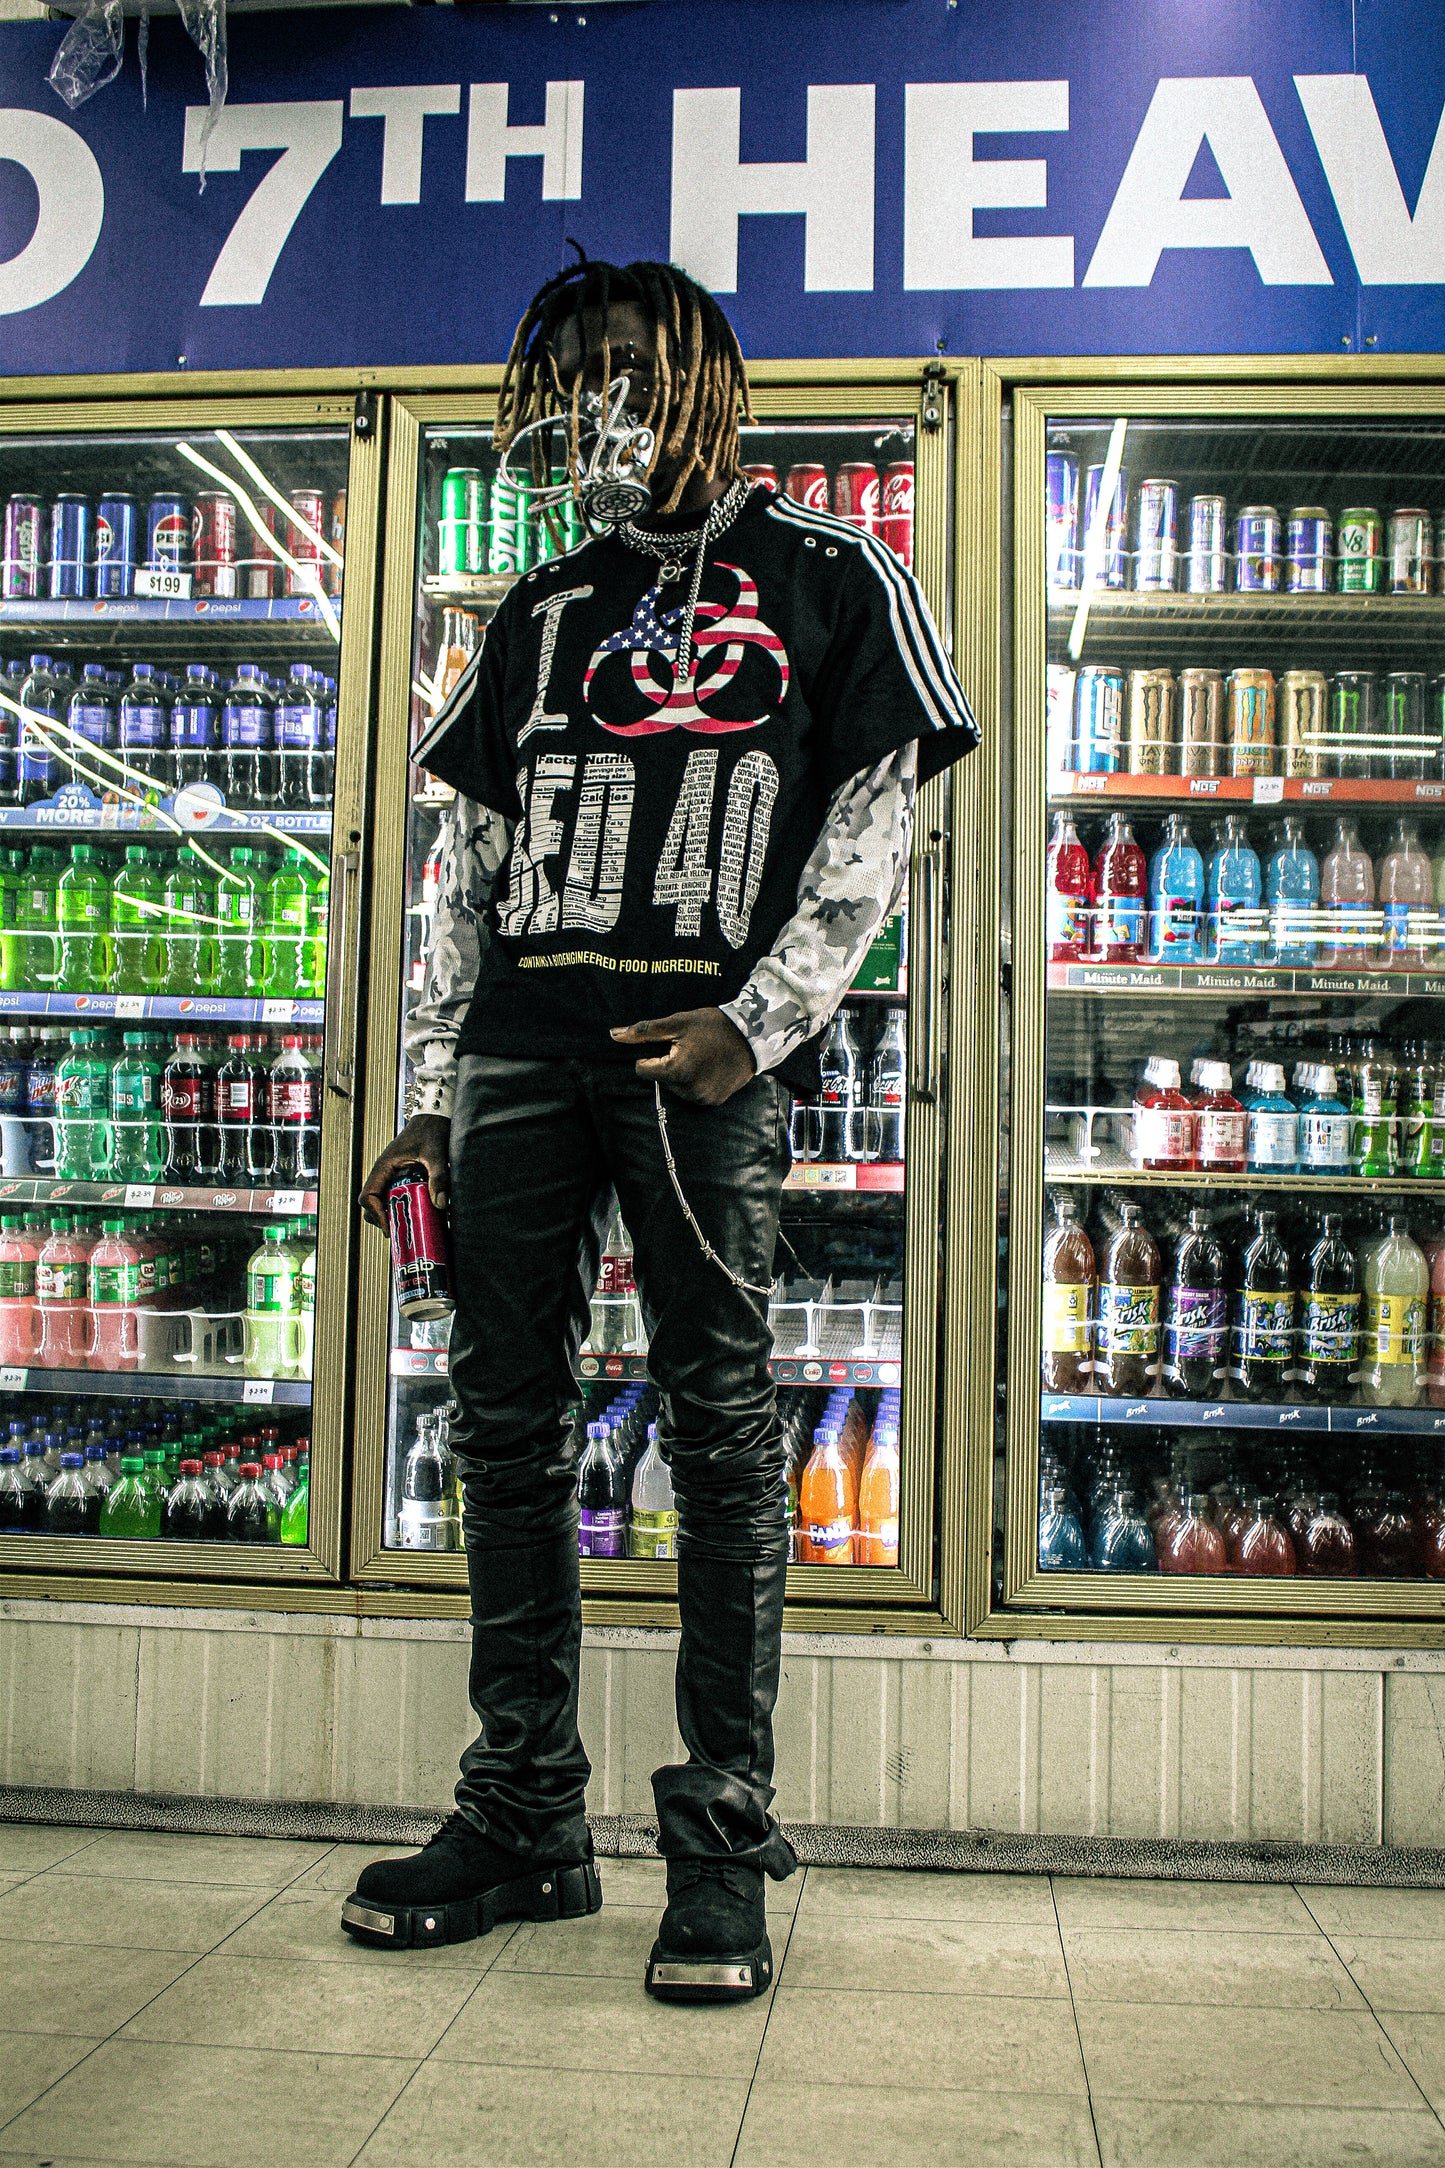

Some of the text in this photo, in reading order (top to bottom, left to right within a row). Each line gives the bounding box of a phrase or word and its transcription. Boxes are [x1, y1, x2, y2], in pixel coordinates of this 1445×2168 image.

[1342, 528, 1364, 553] V8
[149, 576, 181, 593] $1.99
[210, 602, 241, 613] pepsi
[1077, 776, 1445, 796] NOS NOS NOS NOS
[58, 794, 90, 808] 20%
[36, 807, 95, 823] MORE
[552, 951, 616, 970] BIOENGINEERED
[619, 959, 648, 973] FOOD
[650, 958, 722, 977] INGREDIENT.
[1084, 971, 1128, 985] Minute
[1130, 972, 1163, 985] Maid
[1197, 974, 1242, 988] Minute
[1244, 975, 1276, 989] Maid
[1311, 977, 1355, 990] Minute
[1357, 979, 1389, 991] Maid
[195, 1002, 227, 1015] pepsi
